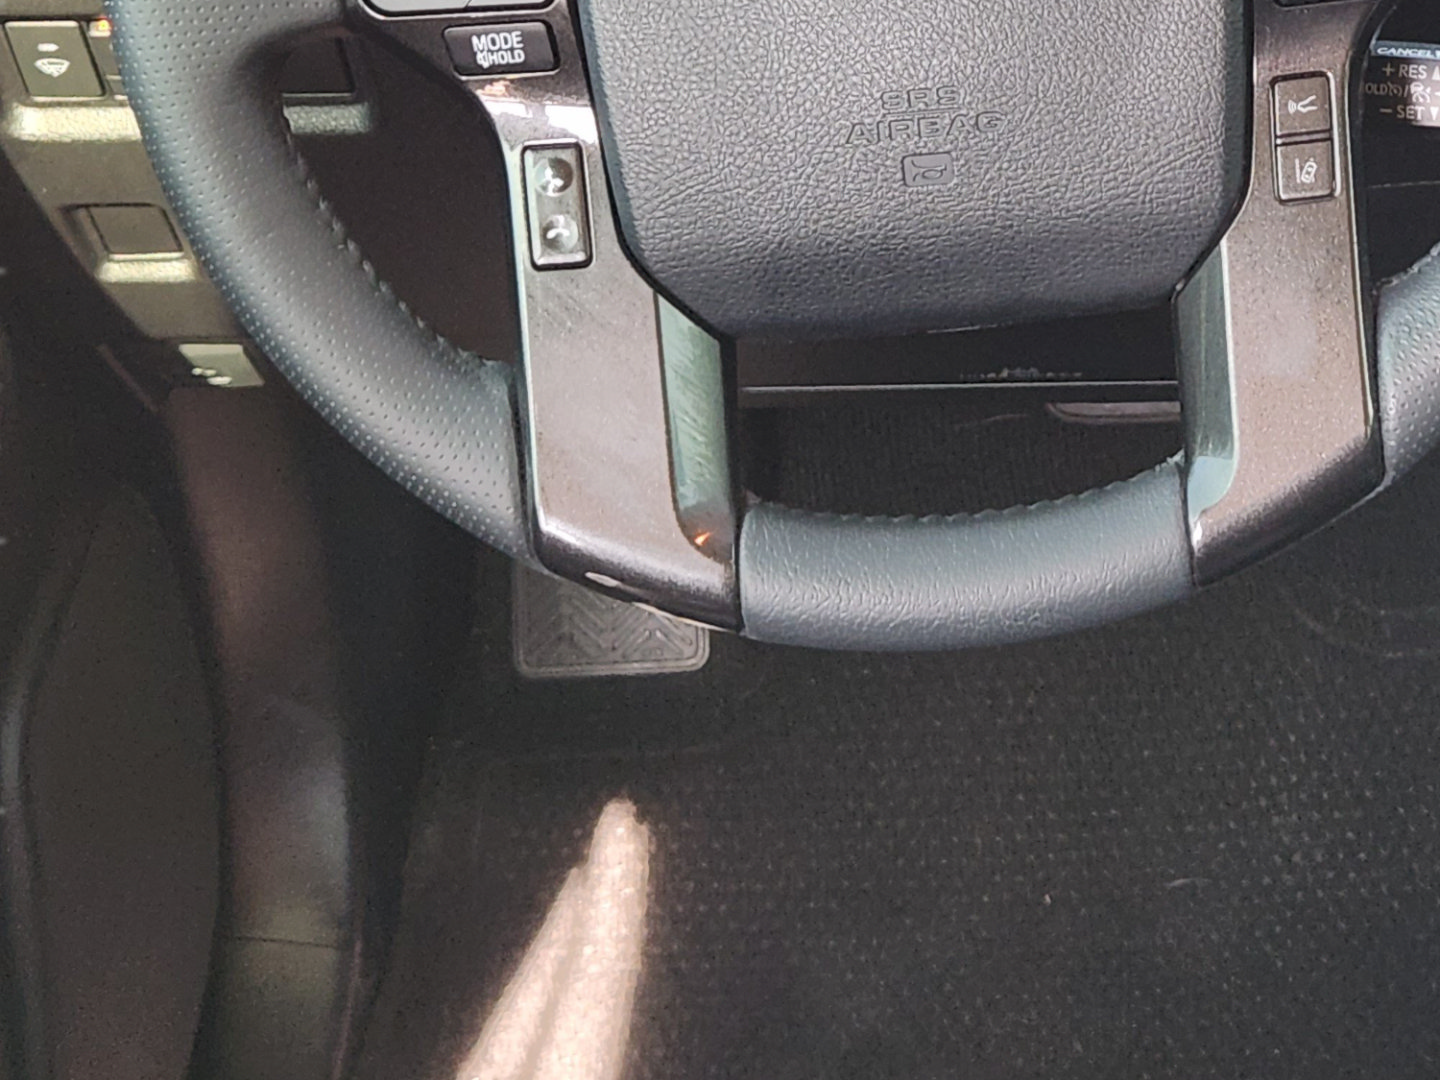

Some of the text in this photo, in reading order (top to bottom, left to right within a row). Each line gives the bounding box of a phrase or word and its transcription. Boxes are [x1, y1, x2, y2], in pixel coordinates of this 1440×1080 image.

[472, 30, 525, 54] MODE
[488, 47, 526, 66] HOLD
[1377, 47, 1434, 58] CANCEL
[1398, 63, 1428, 80] RES
[880, 84, 961, 111] SRS
[1396, 105, 1425, 121] SET
[844, 110, 1005, 146] AIRBAG
